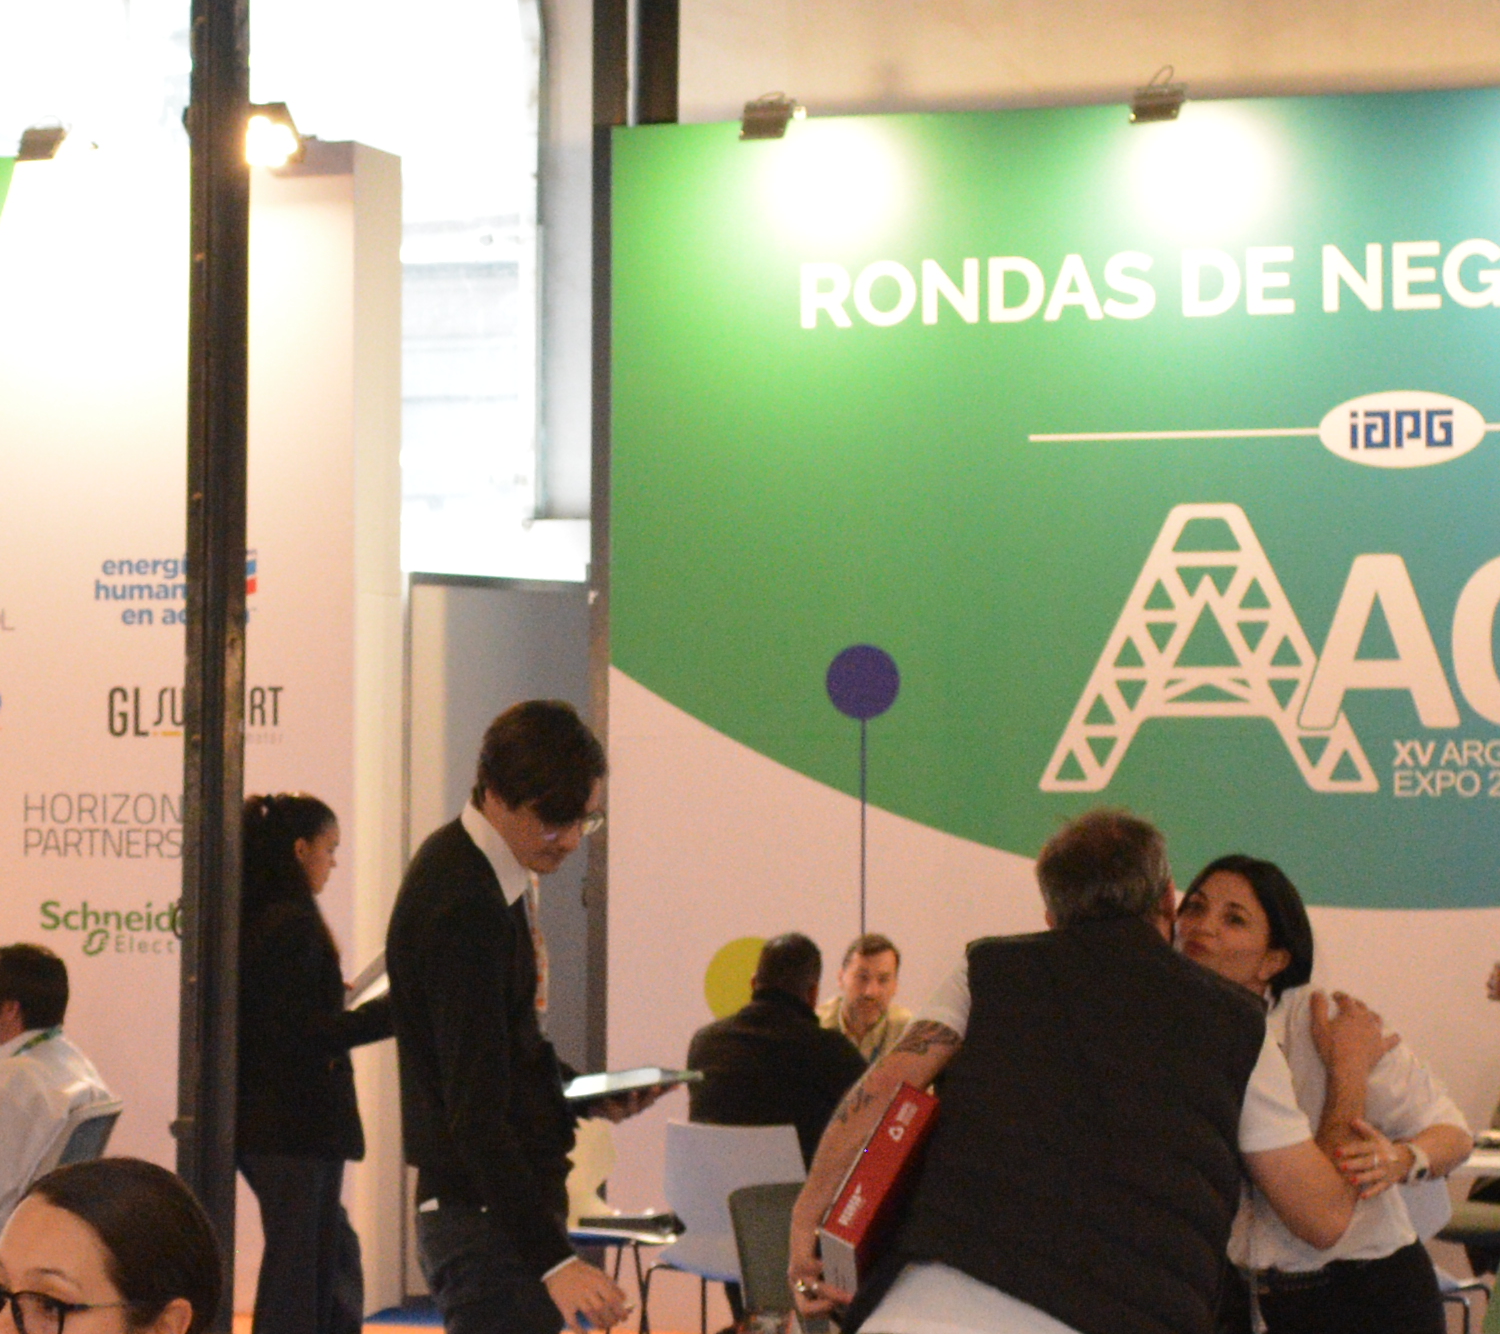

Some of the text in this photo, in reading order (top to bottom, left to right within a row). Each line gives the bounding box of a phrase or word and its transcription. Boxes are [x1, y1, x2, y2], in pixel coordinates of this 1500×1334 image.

[799, 252, 1157, 329] RONDAS
[1180, 246, 1296, 317] DE
[121, 607, 154, 626] en
[1392, 740, 1435, 766] XV
[1393, 772, 1483, 797] EXPO
[23, 792, 184, 825] HORIZON
[23, 827, 183, 860] PARTNERS
